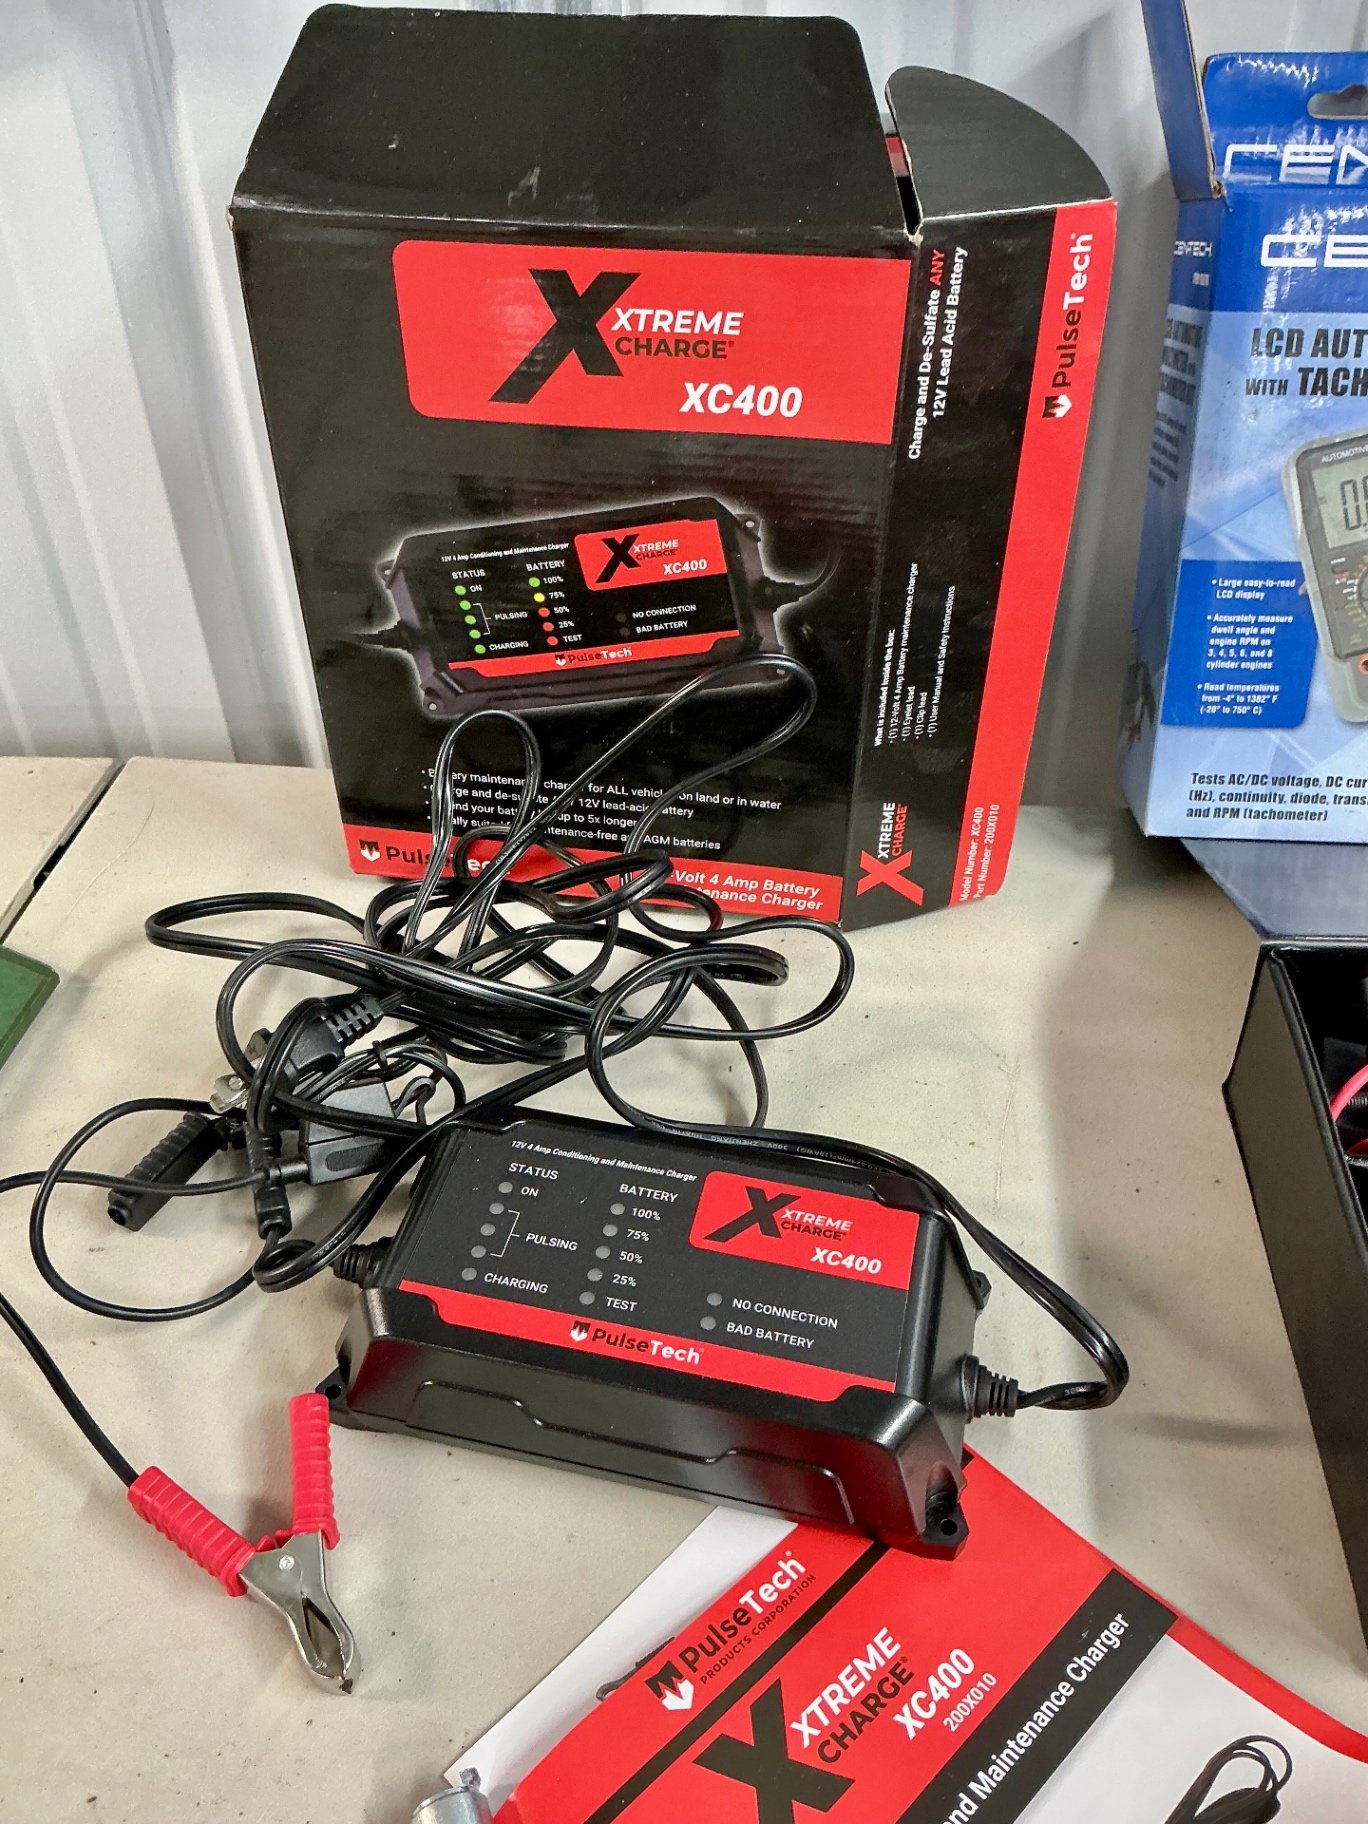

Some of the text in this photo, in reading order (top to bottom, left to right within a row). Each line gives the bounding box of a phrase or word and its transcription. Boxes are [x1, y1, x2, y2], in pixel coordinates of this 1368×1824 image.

[1052, 233, 1093, 388] PulseTech
[611, 307, 744, 336] XTREME
[933, 246, 969, 419] 12V Lead Acid Battery
[614, 336, 731, 359] CHARGE
[1250, 328, 1304, 358] LCD
[908, 249, 945, 460] Charge and De-Sulfate ANY
[1245, 379, 1288, 396] WITH
[679, 382, 803, 418] XC400
[633, 539, 679, 554] XTREME
[636, 548, 677, 561] CHARGE
[451, 569, 486, 580] STATUS
[526, 559, 566, 572] BATTERY
[663, 558, 707, 575] XC400
[470, 584, 482, 593] ON
[543, 575, 564, 584] 100%
[1218, 578, 1296, 589] Large easy-to-read
[548, 591, 565, 599] 75%
[1216, 590, 1265, 600] LCD display
[494, 611, 528, 621] PULSING
[553, 605, 570, 614] 50%
[632, 604, 697, 619] NO CONNECTION
[1213, 613, 1294, 624] Accurately measure
[558, 621, 575, 629] 25%
[636, 620, 688, 634] BAD BATTERY
[1260, 626, 1276, 634] and
[489, 640, 529, 652] CHARGING
[562, 633, 583, 643] TEST
[890, 562, 918, 727] 12-Volt Amp Battery maintenance charger
[1209, 637, 1259, 647] engine RPM
[568, 647, 632, 663] PulseTech
[929, 585, 956, 722] User Manual and Safety Instructions
[1250, 649, 1265, 657] and
[1206, 660, 1273, 670] cylinder engines
[874, 726, 883, 747] What
[884, 647, 893, 662] the
[905, 686, 916, 703] lead
[1204, 683, 1280, 693] Read temperatures
[916, 691, 928, 724] Clip lead
[1201, 694, 1220, 703] from
[1191, 772, 1225, 786] Tests
[1228, 773, 1268, 786] AC/DC
[1271, 774, 1322, 789] voltage,
[1325, 776, 1343, 788] DC
[472, 789, 492, 799] and
[578, 798, 600, 808] 12V
[588, 783, 604, 793] for
[606, 785, 629, 796] ALL
[695, 792, 720, 804] land
[722, 796, 735, 805] or
[737, 797, 747, 806] in
[749, 800, 782, 810] water
[1188, 790, 1329, 806] (Hz), continuity, diode,
[471, 805, 495, 814] your
[574, 814, 585, 823] to
[588, 815, 601, 824] 5x
[603, 816, 637, 828] longer
[1186, 807, 1328, 822] and RPM (tachometer)
[877, 802, 896, 859] XTREME
[891, 805, 908, 857] CHARGE
[984, 804, 1000, 844] 200X010
[643, 835, 671, 845] AGM
[673, 837, 721, 850] batteries
[960, 807, 984, 901] Model Number: XC400
[978, 846, 992, 879] Number:
[709, 874, 820, 898] 4 Amp Battery
[761, 892, 823, 911] Charger
[511, 1140, 698, 1182] 12V Amp Conditioning and Maintenance Charger
[508, 1162, 559, 1180] STATUS
[521, 1186, 539, 1197] ON
[619, 1183, 679, 1203] BATTERY
[632, 1207, 661, 1221] 100%
[781, 1208, 853, 1231] XTREME
[626, 1228, 650, 1242] 75%
[781, 1220, 843, 1241] CHARGE
[525, 1232, 578, 1251] PULSING
[619, 1251, 643, 1264] 50%
[810, 1246, 883, 1274] XC400
[484, 1272, 549, 1294] CHARGING
[612, 1274, 637, 1287] 25%
[606, 1296, 638, 1312] TEST
[732, 1298, 838, 1329] NO CONNECTION
[726, 1321, 815, 1349] BAD BATTERY
[591, 1326, 701, 1365] PulseTech
[678, 1556, 807, 1674] PulseTech
[701, 1574, 817, 1684] PRODUCTS CORPORATION
[790, 1626, 901, 1749] XTREME
[892, 1648, 975, 1740] XC400
[943, 1672, 998, 1732] 200X010
[968, 1681, 1075, 1801] Maintenance
[1066, 1613, 1130, 1682] Charger
[817, 1661, 915, 1764] CHARGE
